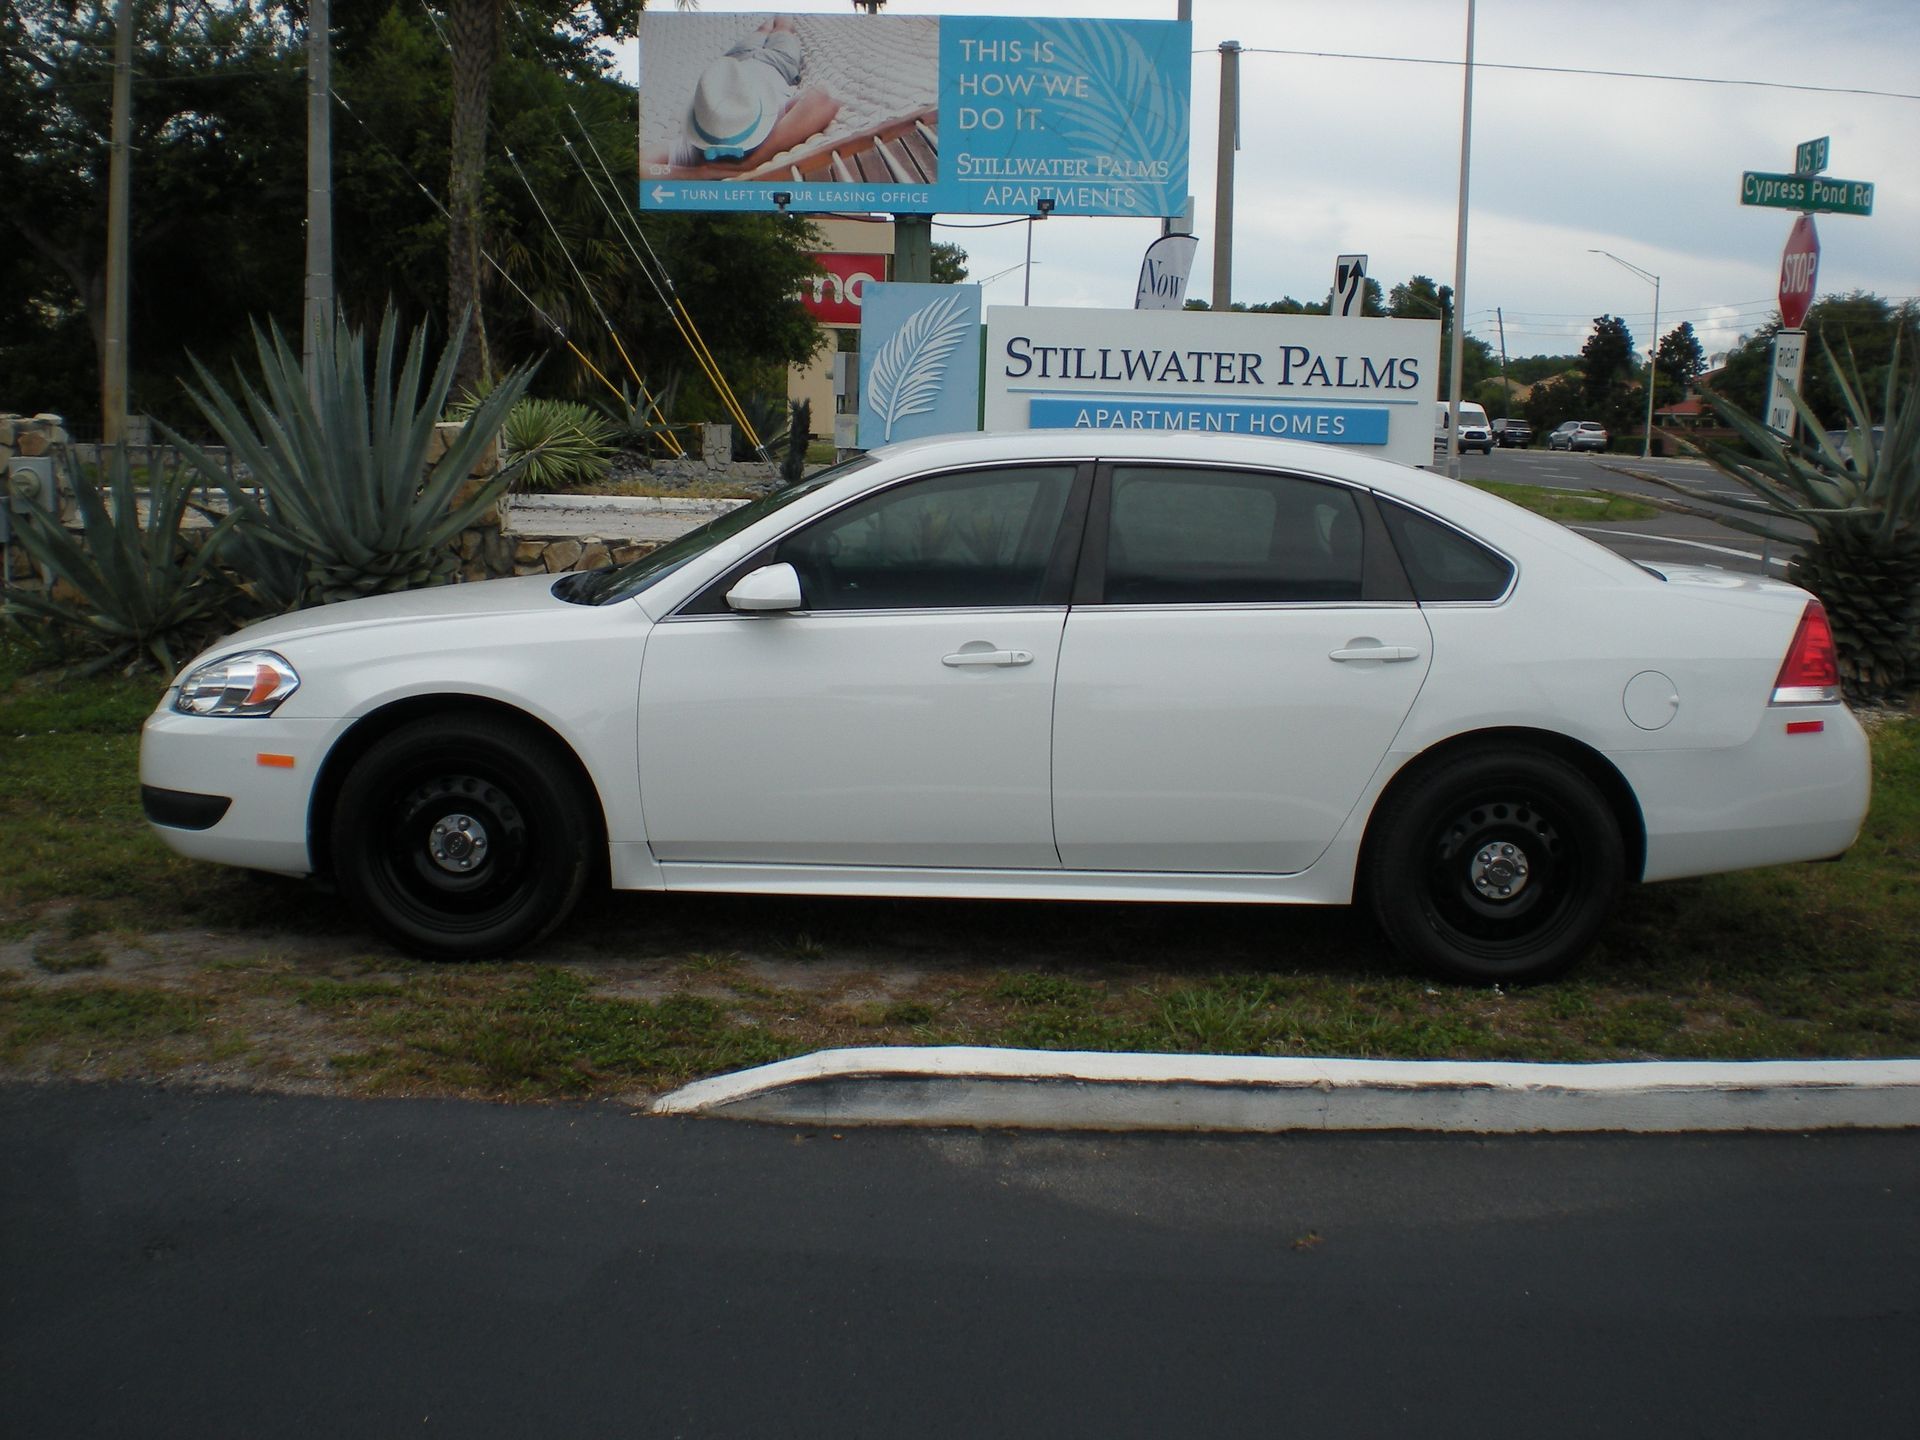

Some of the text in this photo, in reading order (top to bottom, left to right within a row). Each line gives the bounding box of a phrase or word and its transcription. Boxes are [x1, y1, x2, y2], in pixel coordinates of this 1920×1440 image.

[959, 39, 1055, 63] THIS IS
[960, 73, 1089, 98] HOW WE
[959, 107, 1045, 130] DO IT.
[957, 153, 1169, 178] STILLWATER PALMS
[1799, 140, 1825, 171] US 19
[681, 188, 719, 201] TURN
[724, 189, 754, 201] LEFT
[819, 191, 876, 203] LEASING
[881, 192, 929, 203] OFFICE
[983, 186, 1136, 208] APARTMENTS
[1744, 174, 1872, 206] Cypress Pond Rd
[1781, 252, 1817, 294] STOP
[1005, 336, 1420, 390] STILLWATER PALMS
[1074, 408, 1345, 435] APARTMENT HOMES
